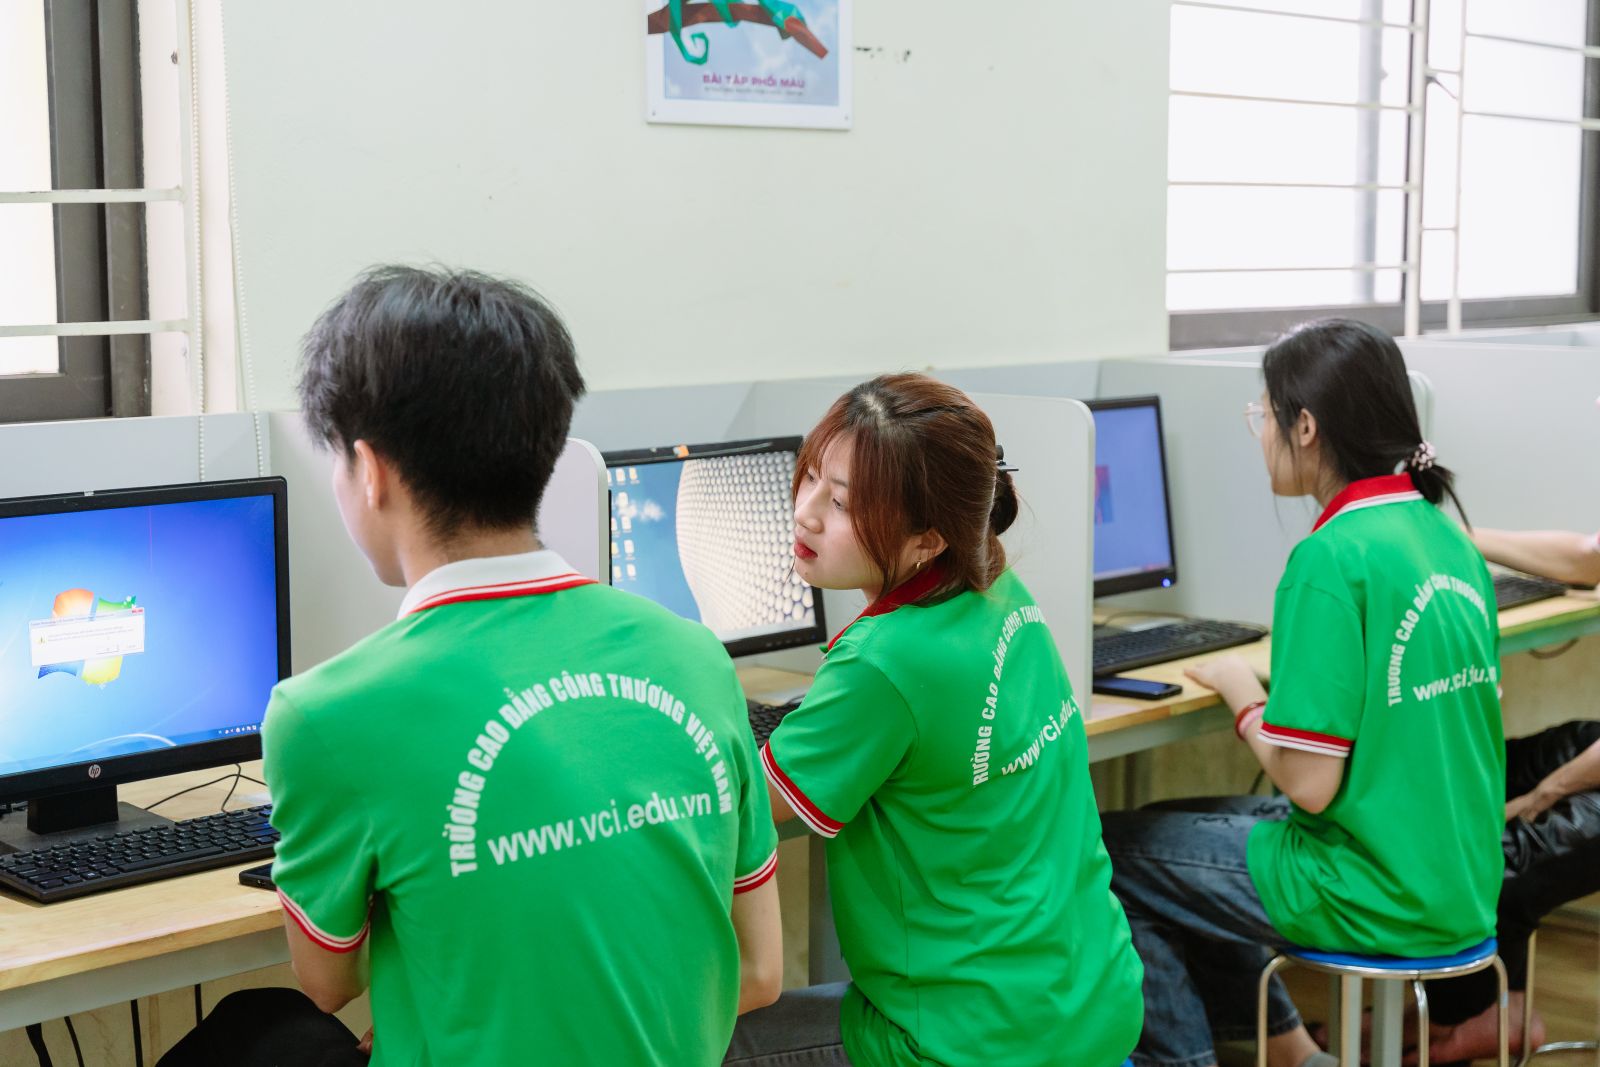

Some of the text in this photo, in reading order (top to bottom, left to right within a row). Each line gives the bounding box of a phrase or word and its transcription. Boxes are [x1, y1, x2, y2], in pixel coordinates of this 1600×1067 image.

[1395, 608, 1420, 642] CAO
[981, 682, 999, 720] CAO
[467, 719, 510, 772] CAO
[548, 670, 606, 702] CÔNG
[606, 673, 686, 725] THƯƠNG
[685, 712, 719, 761] VIỆT
[711, 760, 732, 815] NAM
[970, 725, 993, 787] RƯỜNG
[88, 764, 101, 779] hp
[487, 791, 712, 866] www.vci.edu.vn
